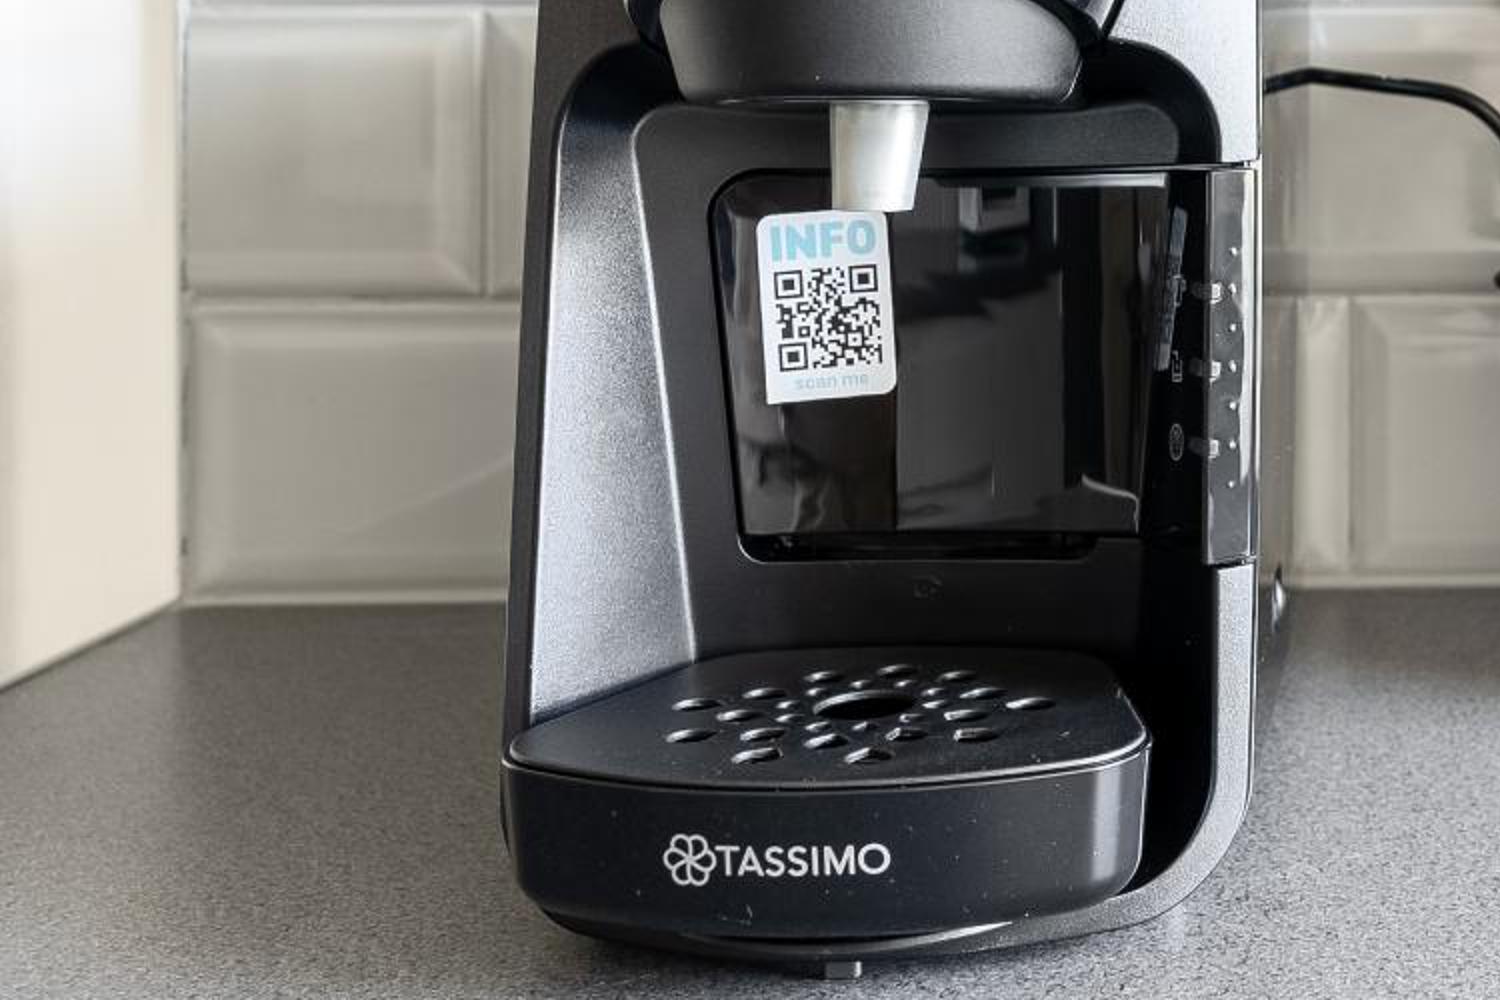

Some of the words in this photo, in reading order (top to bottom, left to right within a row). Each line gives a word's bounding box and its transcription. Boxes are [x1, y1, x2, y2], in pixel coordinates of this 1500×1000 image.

[770, 219, 876, 263] INFO
[795, 376, 838, 391] scan
[842, 374, 869, 388] me
[714, 843, 892, 877] TASSIMO
